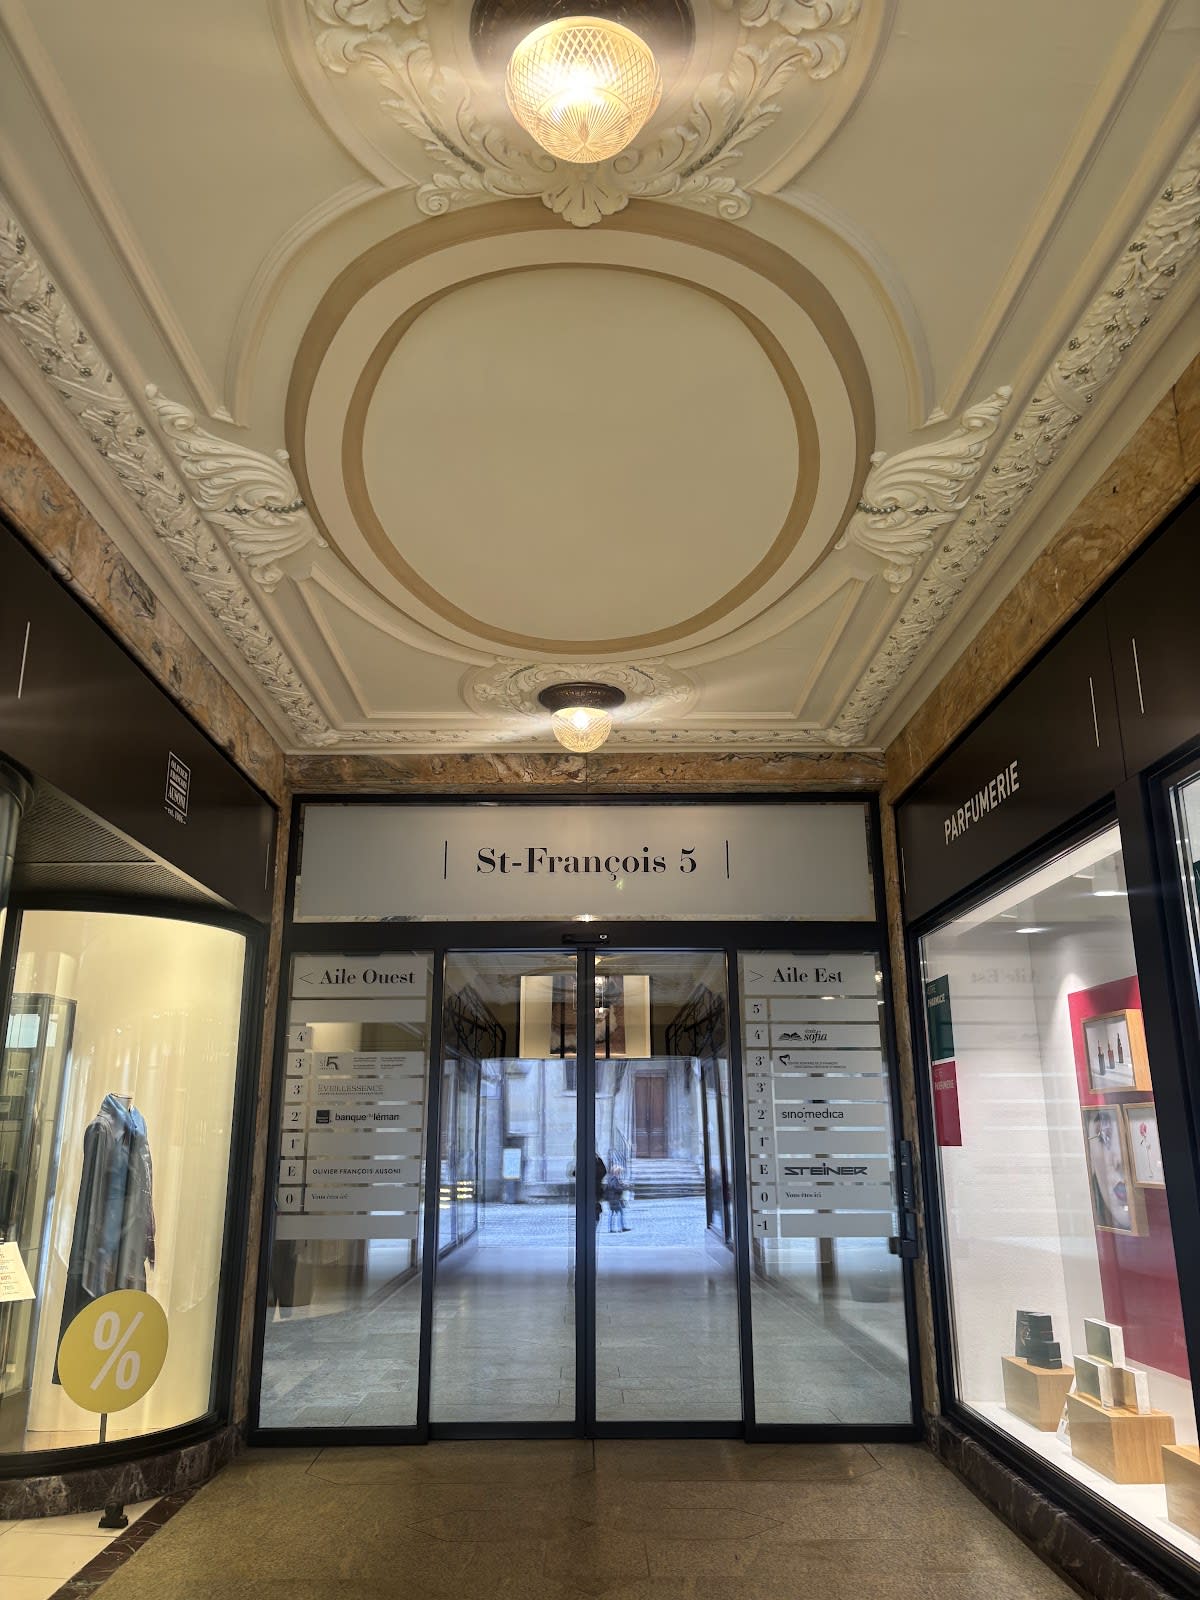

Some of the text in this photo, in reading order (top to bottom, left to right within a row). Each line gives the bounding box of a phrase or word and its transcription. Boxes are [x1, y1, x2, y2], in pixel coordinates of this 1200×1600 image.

[943, 760, 1020, 845] PARFUMERIE
[475, 846, 697, 881] St-François 5
[320, 968, 416, 985] Aile Ouest
[773, 967, 843, 984] Aile Est
[335, 1112, 367, 1123] banque
[373, 1112, 401, 1121] léman
[760, 1164, 769, 1175] E
[784, 1162, 868, 1176] STEINER
[285, 1193, 293, 1204] 0
[761, 1192, 769, 1203] 0
[757, 1220, 769, 1231] -1
[90, 1311, 144, 1391] %
